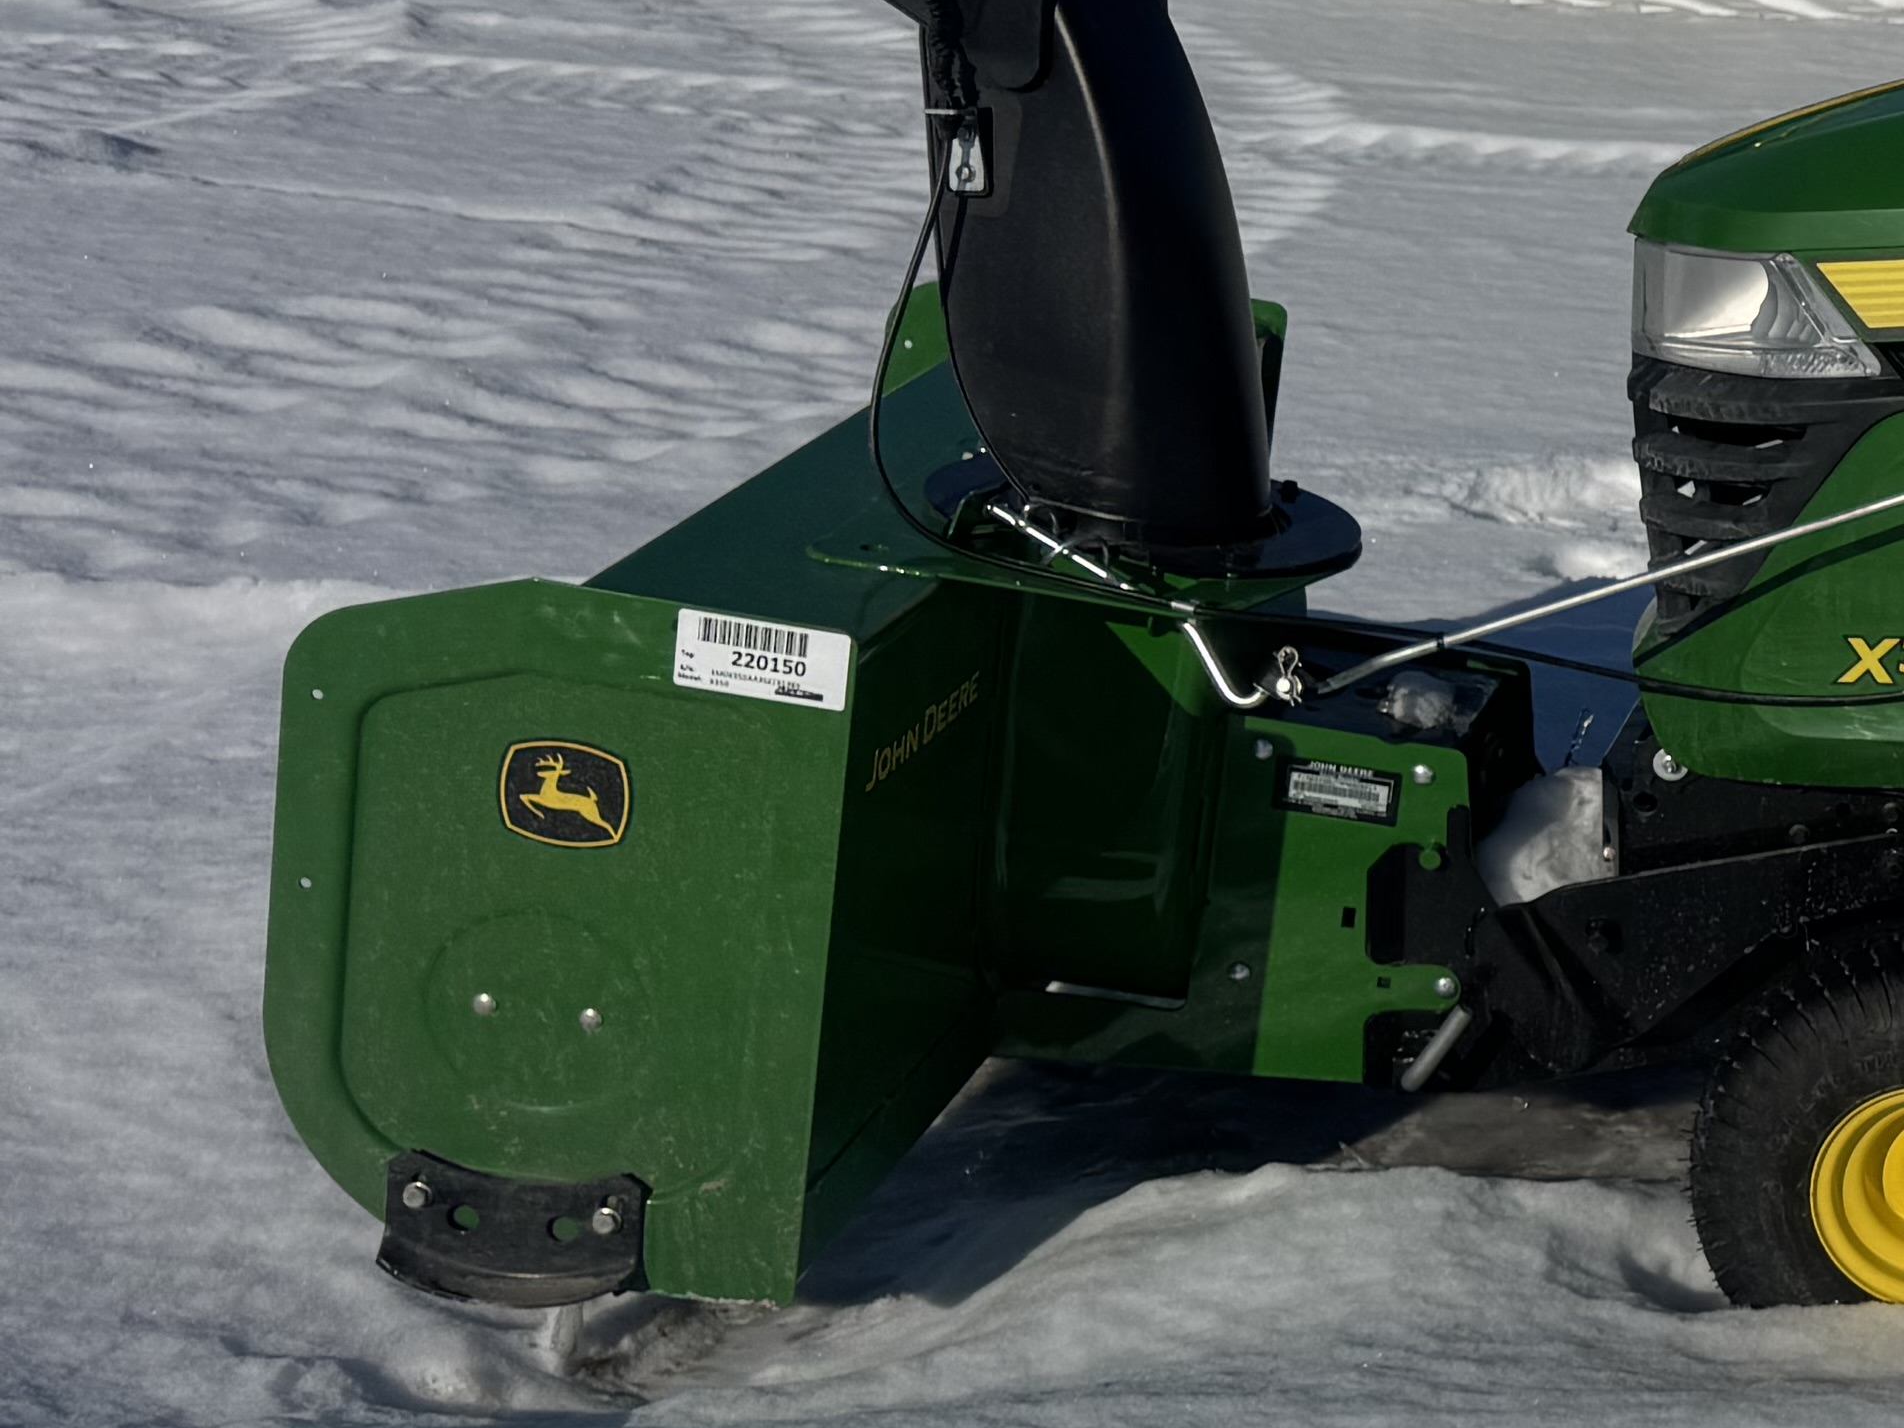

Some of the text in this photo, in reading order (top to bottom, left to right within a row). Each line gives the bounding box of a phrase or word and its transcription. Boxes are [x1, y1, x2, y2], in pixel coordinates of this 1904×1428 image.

[731, 651, 807, 678] 220150
[864, 670, 980, 793] JOHN DEERE
